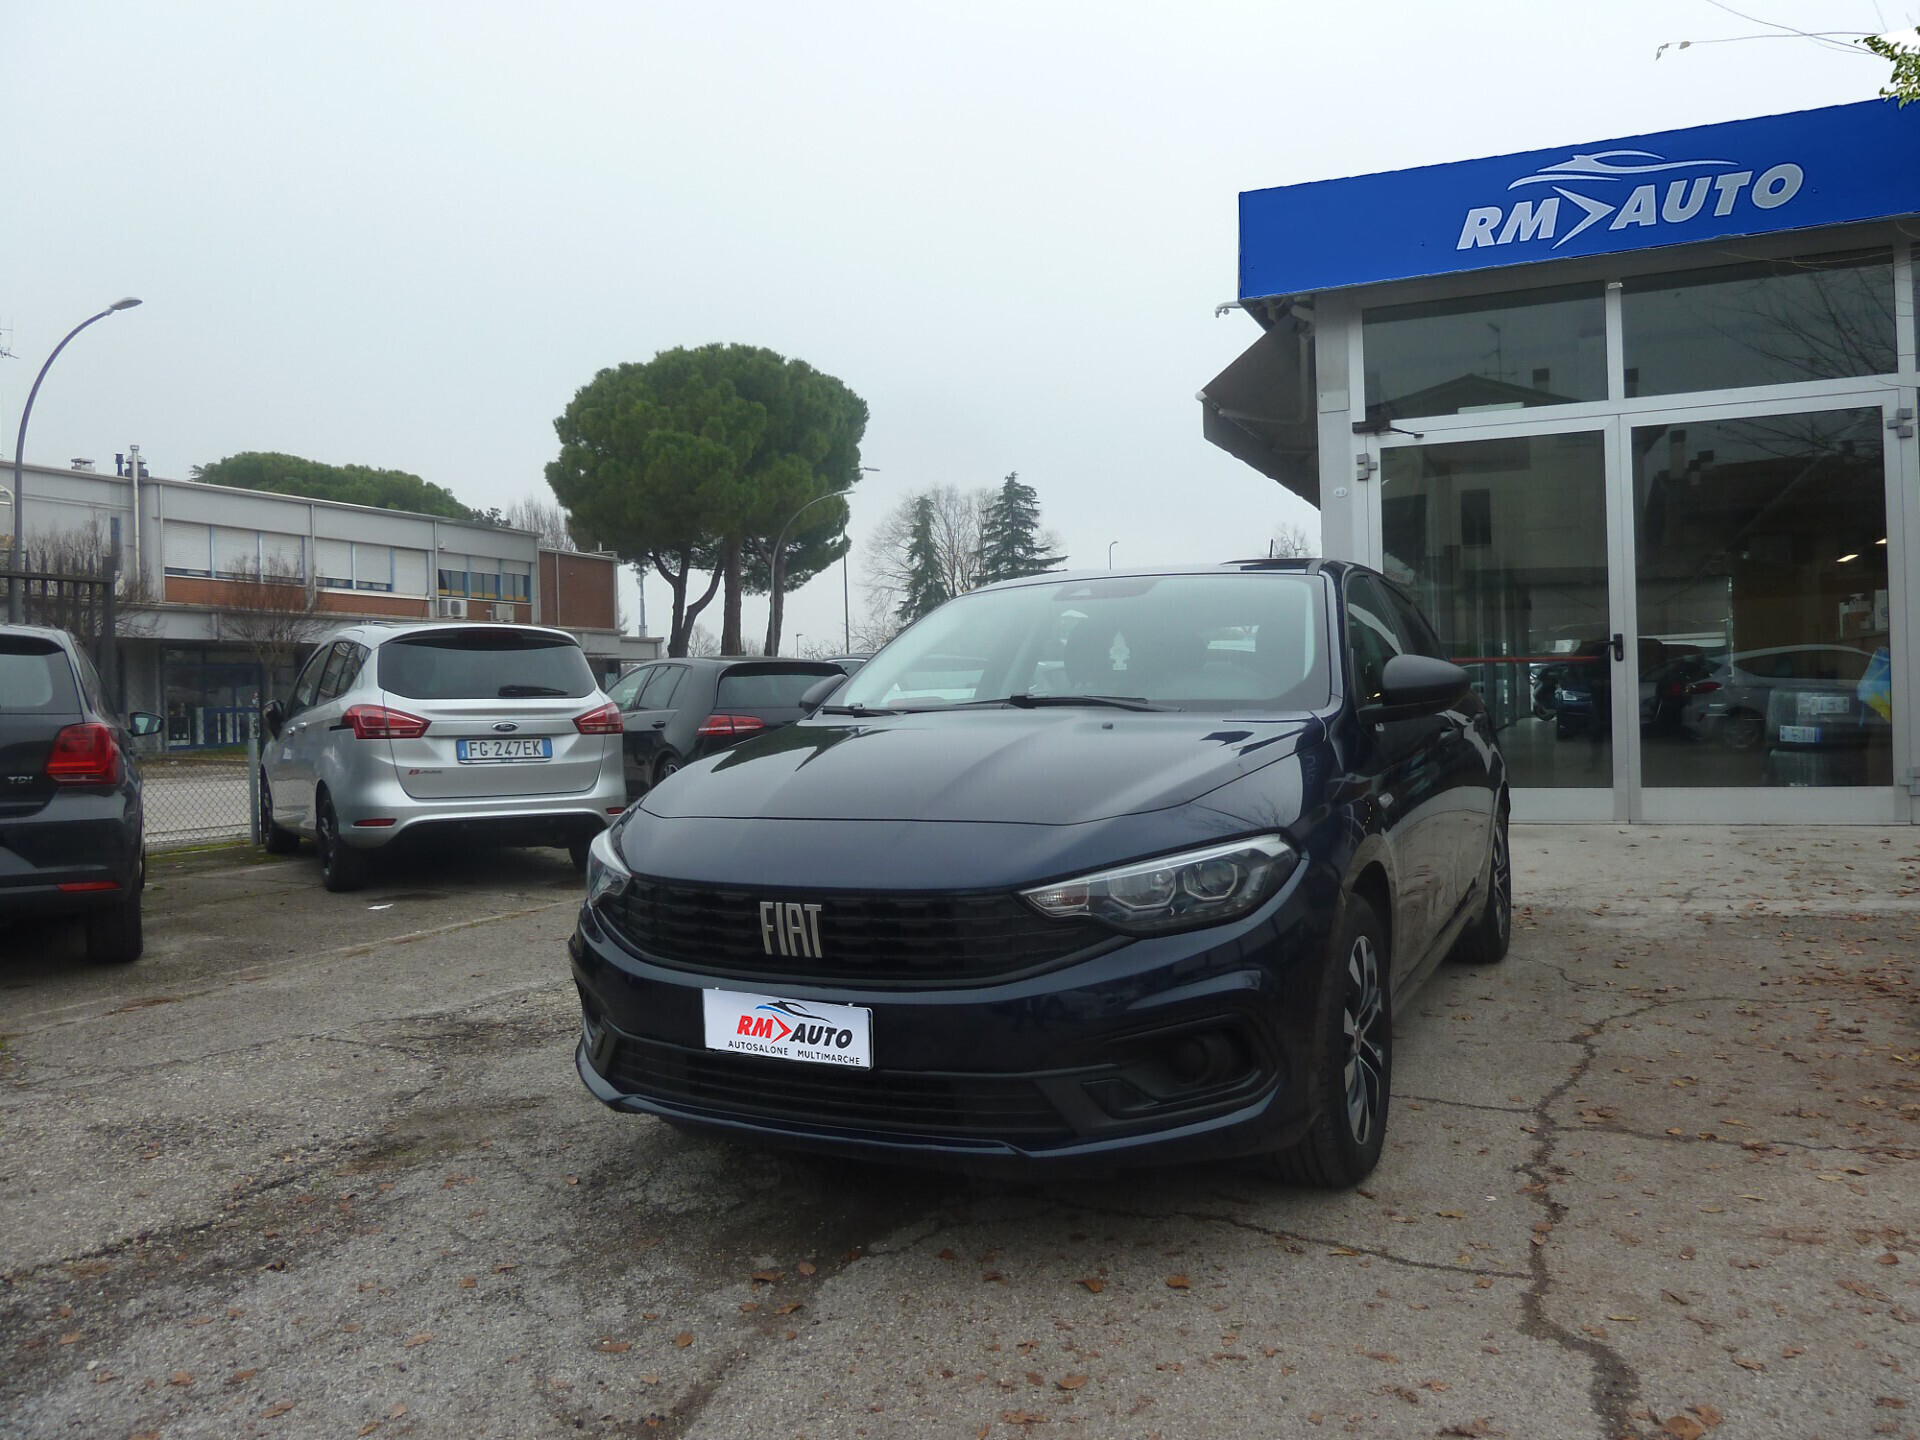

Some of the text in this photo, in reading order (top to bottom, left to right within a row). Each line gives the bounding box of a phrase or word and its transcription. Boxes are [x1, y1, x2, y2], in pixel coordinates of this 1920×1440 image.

[1456, 162, 1804, 250] RM AUTO
[8, 775, 33, 784] TDI
[759, 901, 823, 959] FIAT
[736, 1014, 853, 1050] RM AUTO
[727, 1039, 861, 1066] AUTOSALONE MULTIMARCHE
